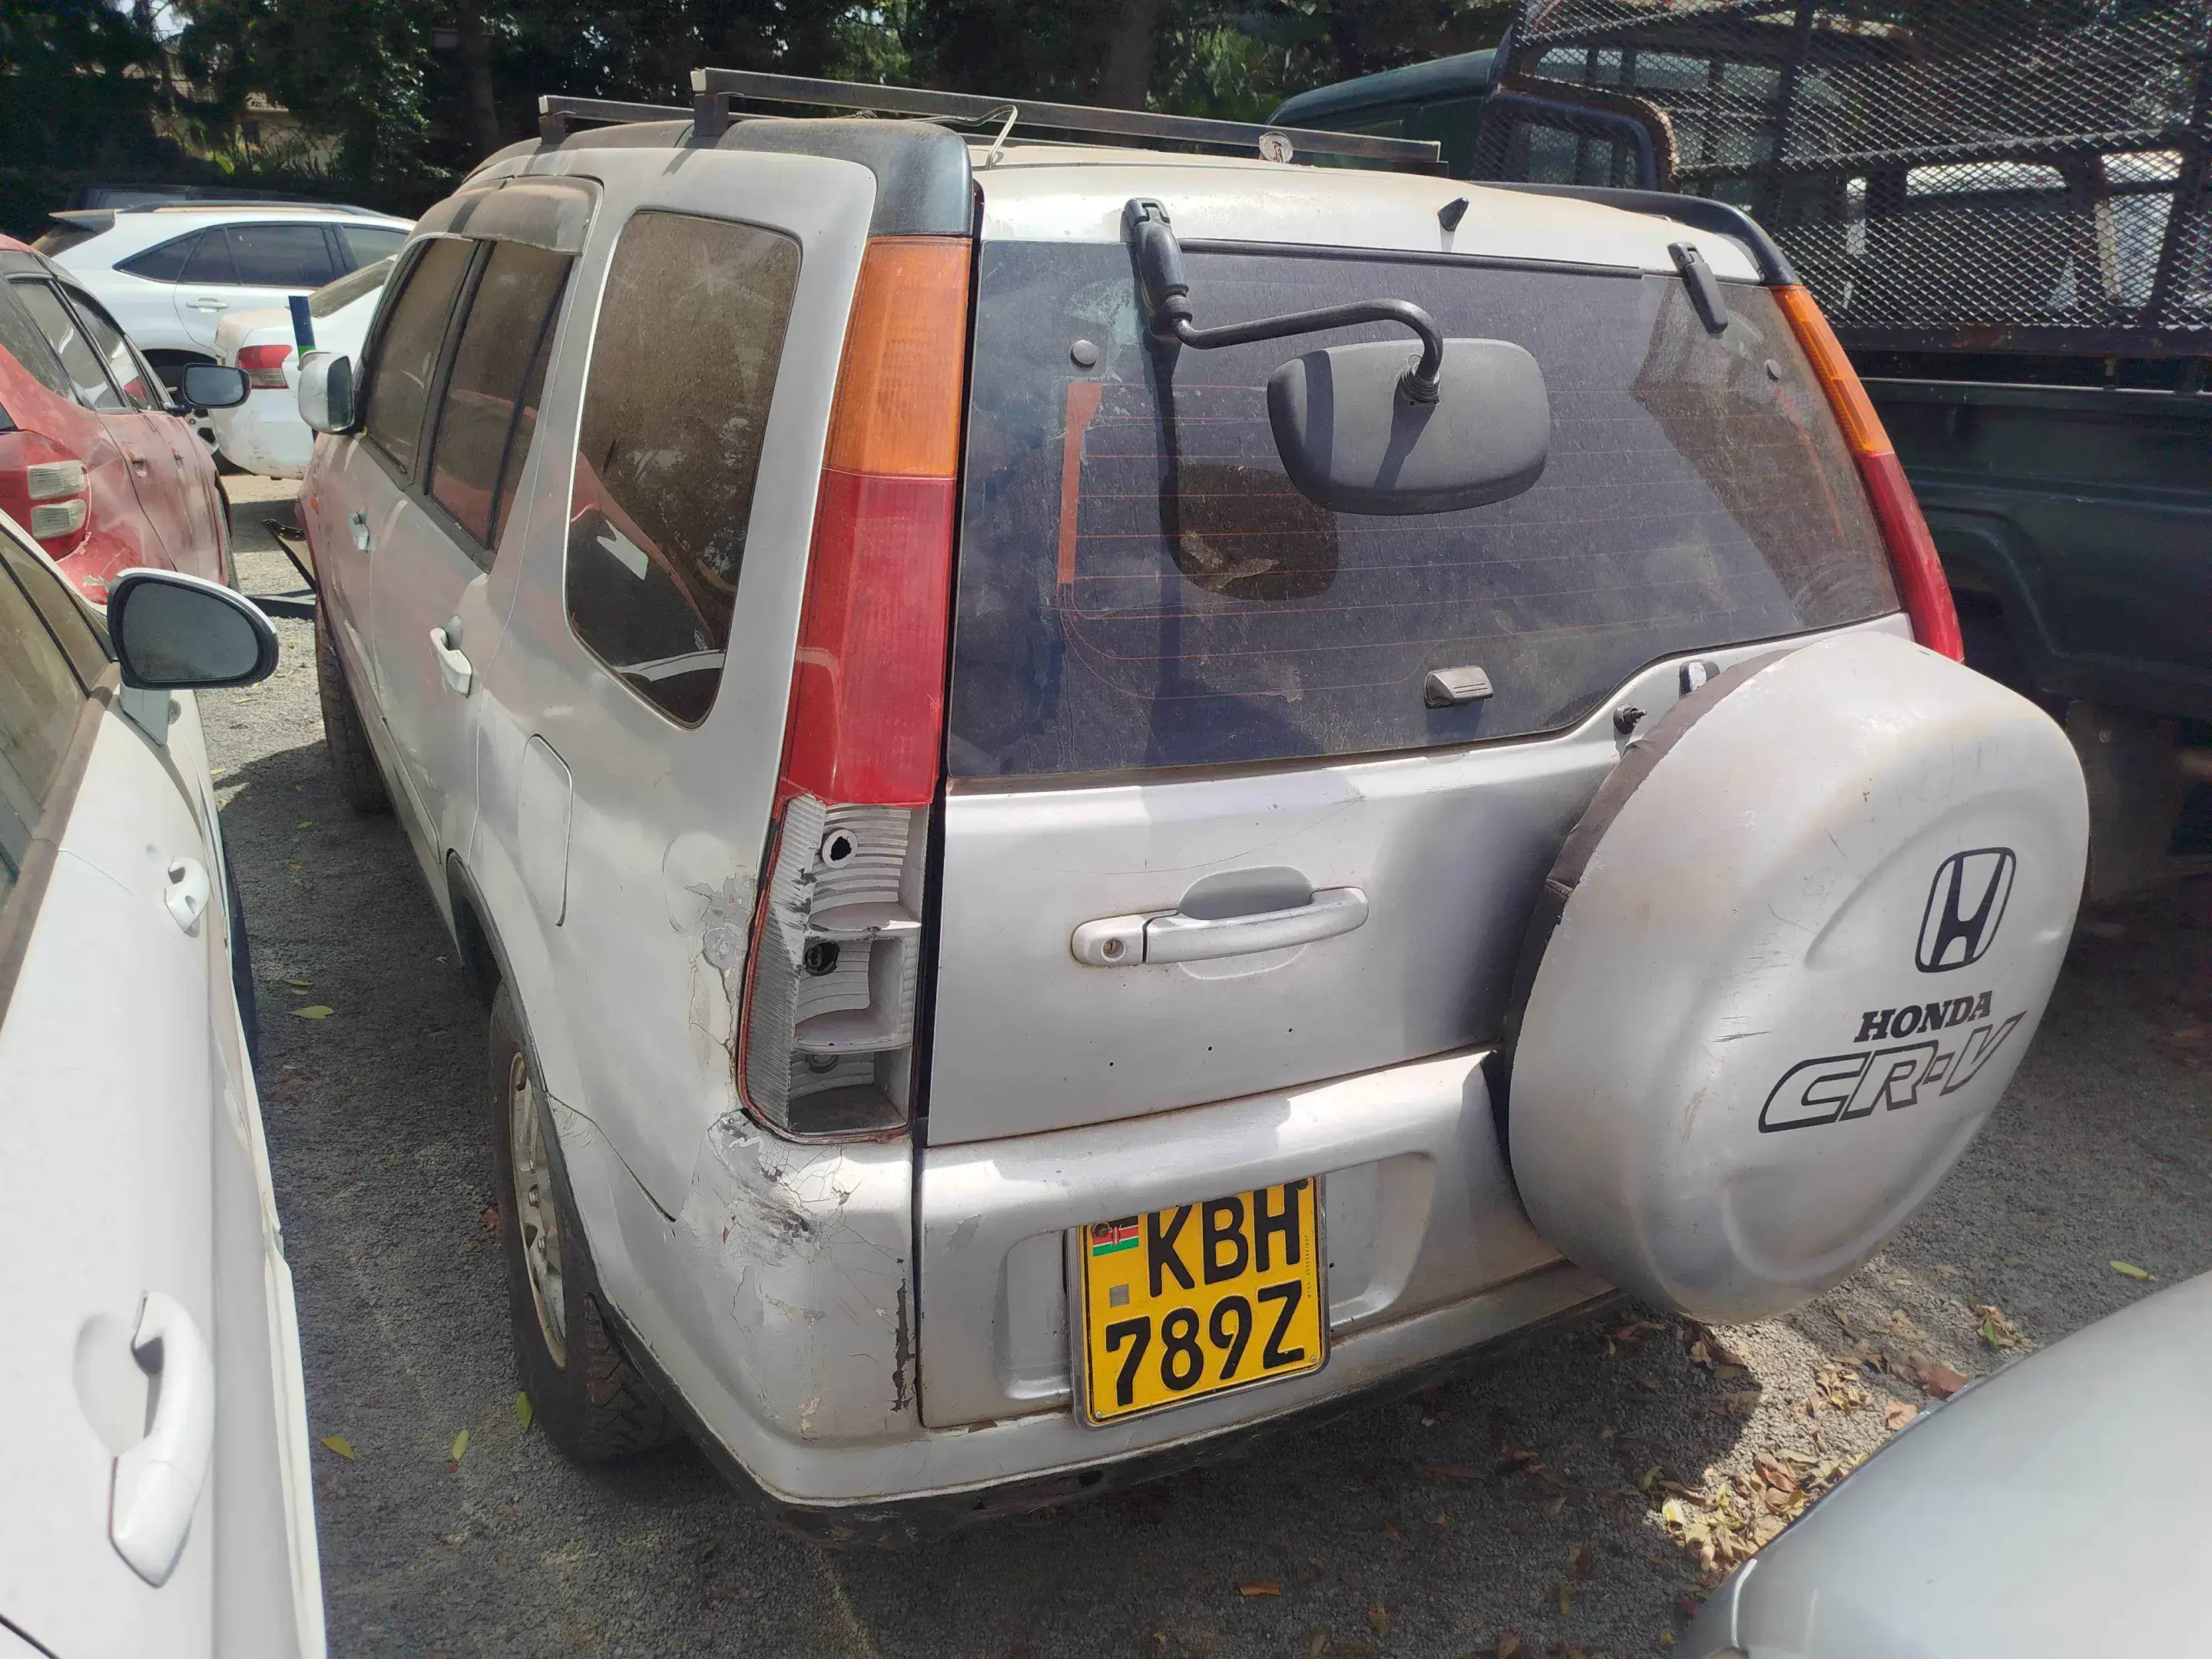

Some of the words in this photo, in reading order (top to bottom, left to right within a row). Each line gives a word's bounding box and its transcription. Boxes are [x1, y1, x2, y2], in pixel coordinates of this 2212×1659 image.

[1758, 1010, 2028, 1134] CR-V
[1853, 990, 1993, 1043] HONDA
[1147, 1184, 1300, 1298] KBH
[1106, 1280, 1305, 1407] 789Z
